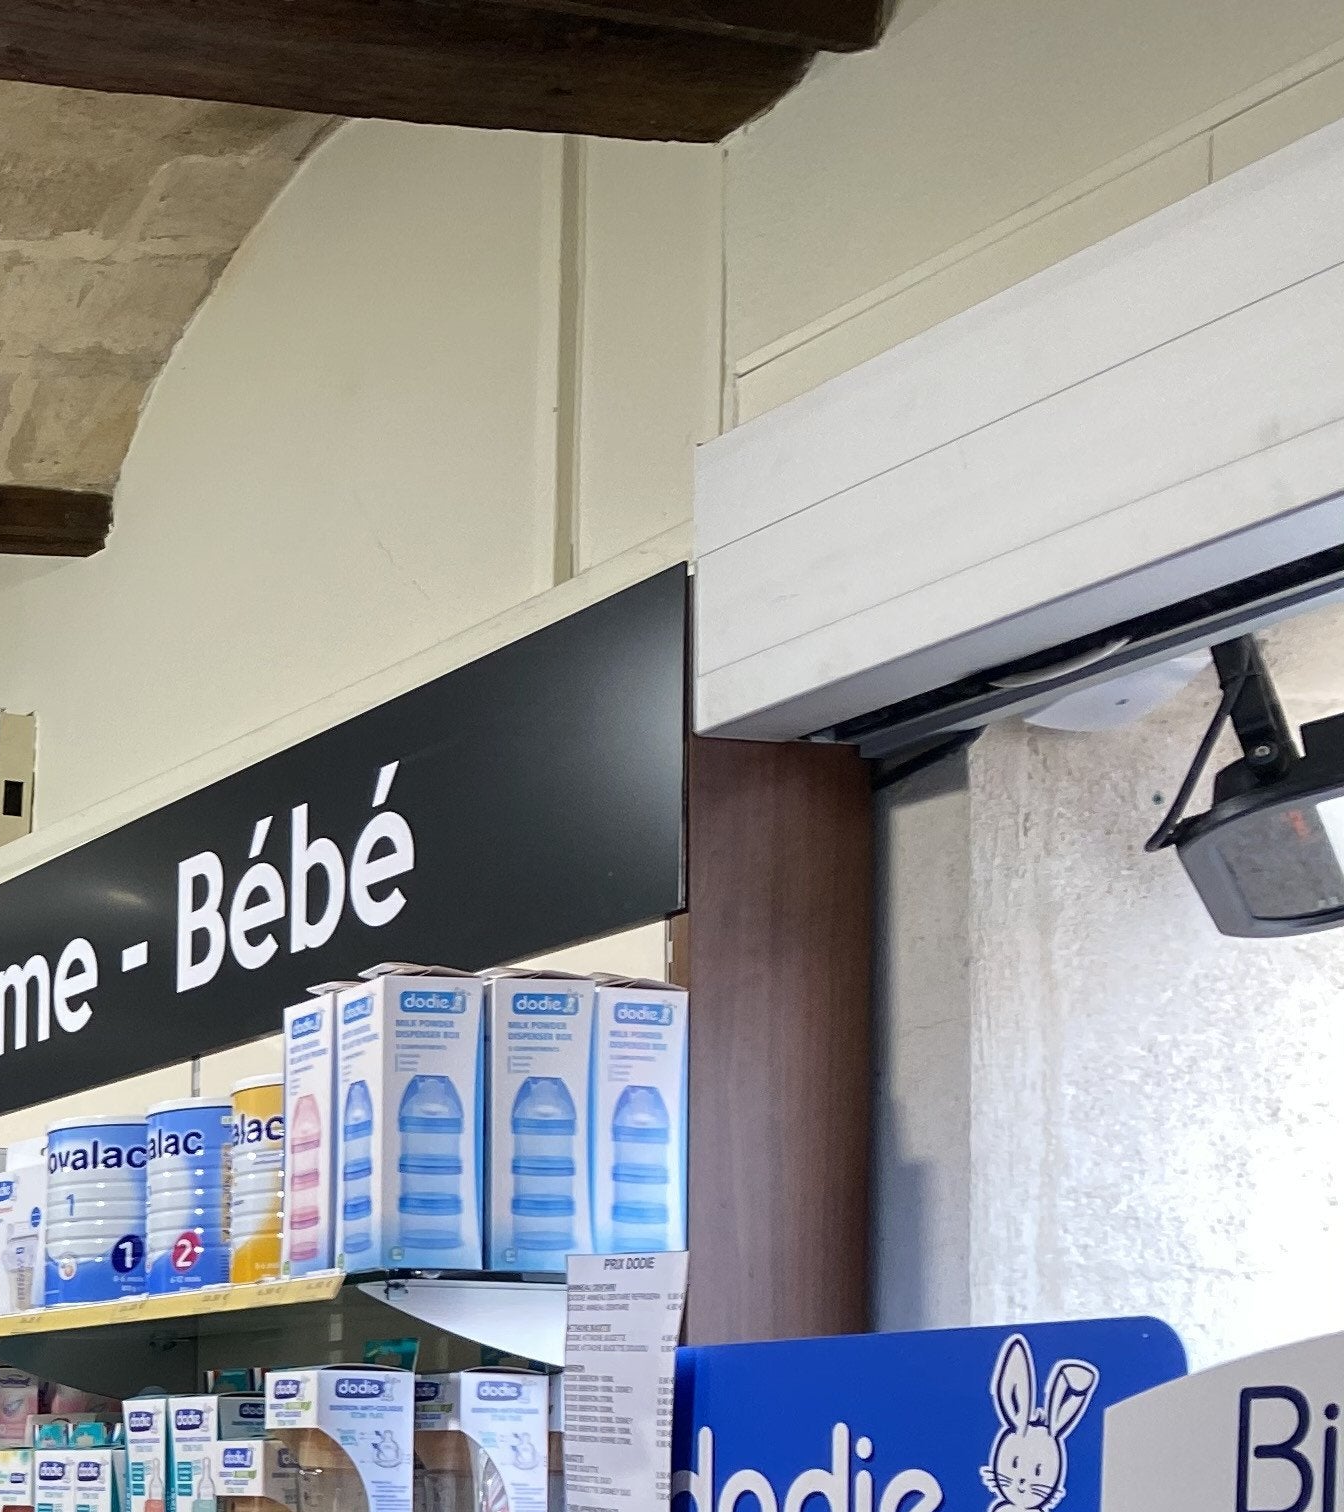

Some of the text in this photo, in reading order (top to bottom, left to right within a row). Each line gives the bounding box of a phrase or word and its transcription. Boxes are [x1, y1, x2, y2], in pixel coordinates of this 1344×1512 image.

[122, 940, 148, 973] -
[176, 759, 415, 994] Bébé
[403, 995, 448, 1009] dodie
[516, 997, 561, 1011] dodie
[119, 1241, 133, 1268] 1
[174, 1240, 192, 1266] 2
[604, 1257, 656, 1270] PRIX DODIE
[338, 1381, 381, 1396] dodie
[478, 1383, 521, 1397] dodie
